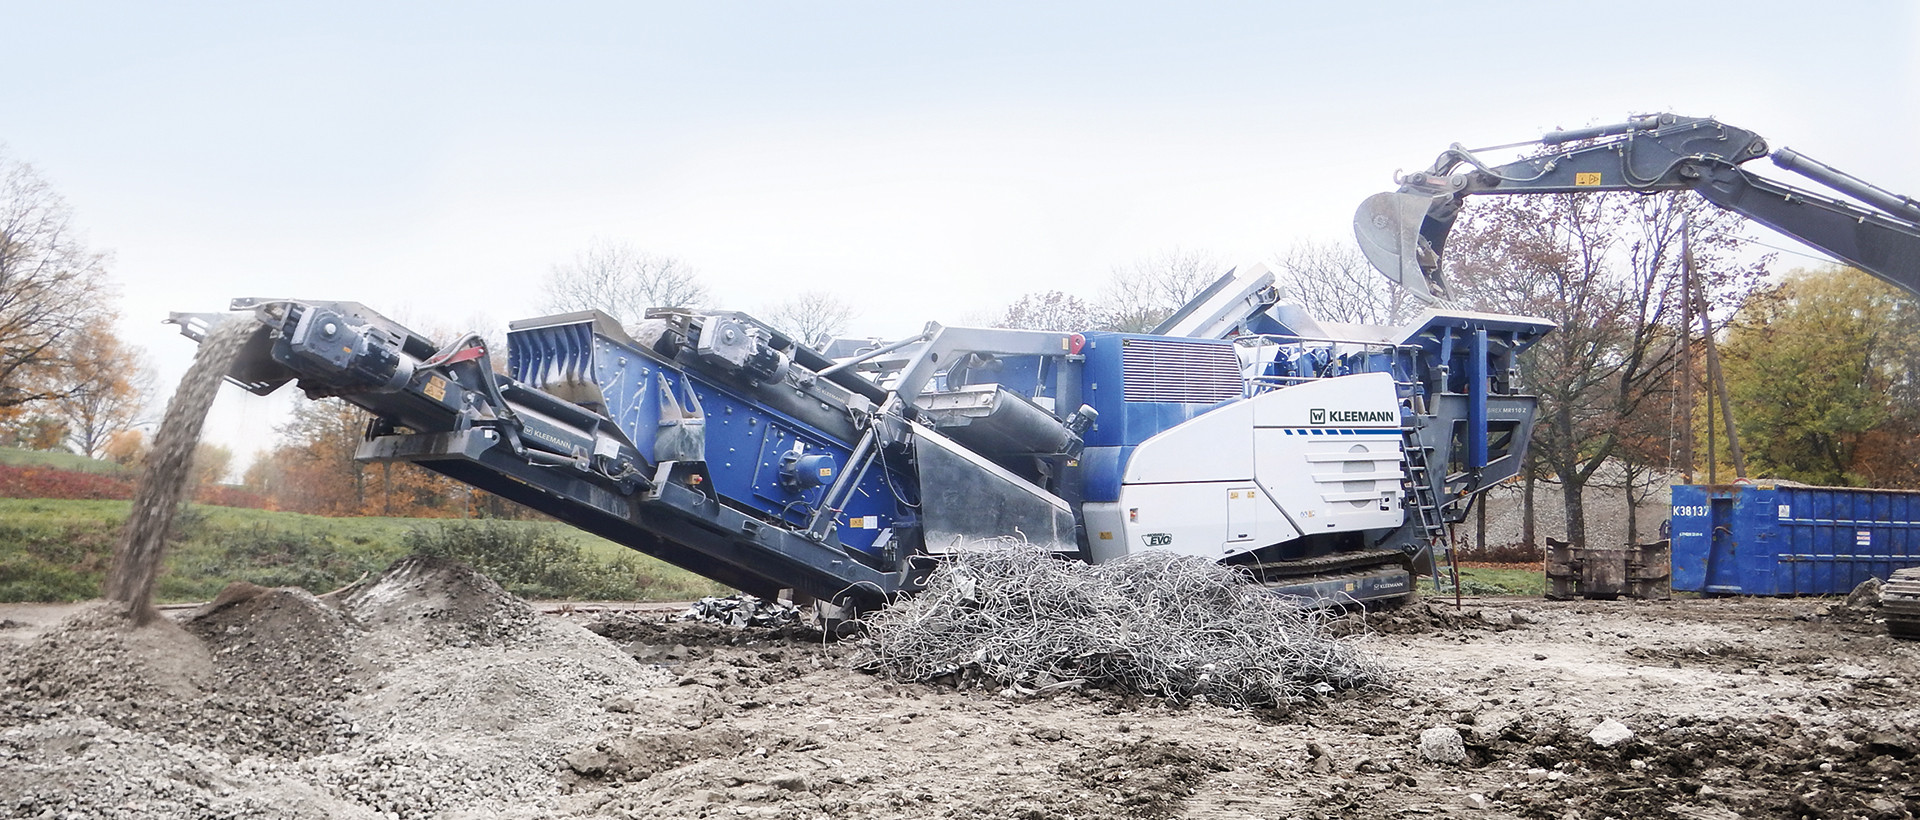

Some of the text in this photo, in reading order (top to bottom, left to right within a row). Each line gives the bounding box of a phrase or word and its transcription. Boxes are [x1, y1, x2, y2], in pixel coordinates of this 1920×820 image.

[1329, 411, 1394, 422] KLEEMANN
[534, 430, 571, 449] KLEEMANN
[1673, 505, 1709, 517] K38137
